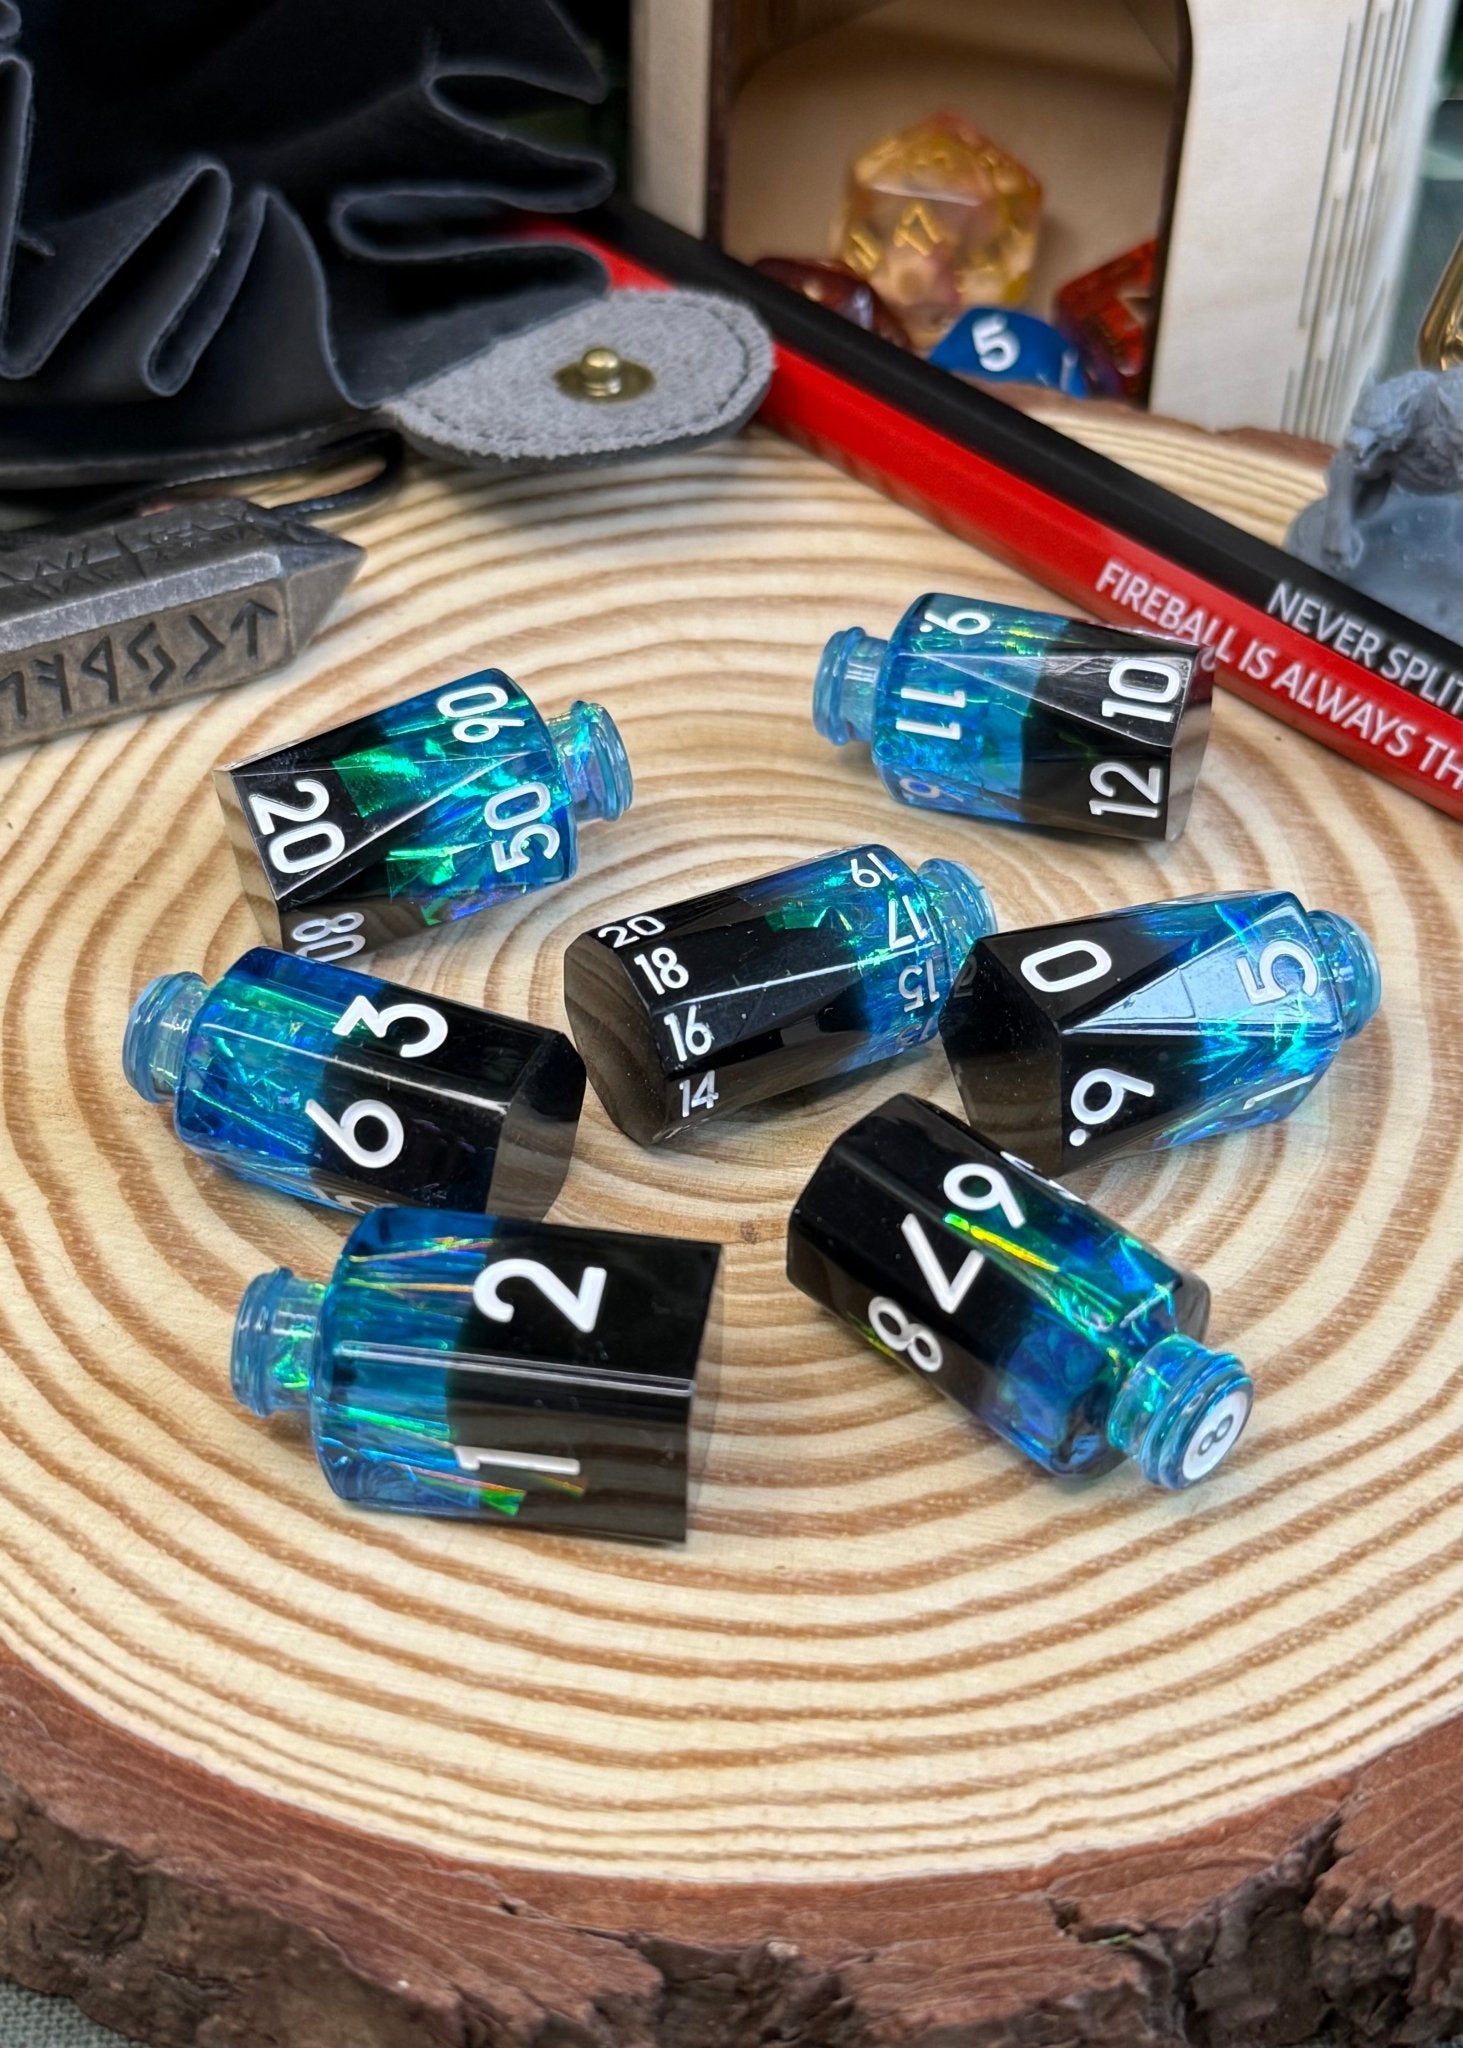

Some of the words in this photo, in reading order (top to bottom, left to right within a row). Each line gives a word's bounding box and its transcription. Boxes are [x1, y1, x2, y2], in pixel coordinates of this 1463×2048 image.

[971, 314, 1020, 373] 5
[1266, 582, 1378, 669] NEVER
[1096, 560, 1237, 663] FIREBALL
[1239, 639, 1277, 681] IS
[1271, 662, 1417, 758] ALWAYS
[895, 687, 967, 741] 11
[1101, 658, 1182, 724] 10
[1088, 760, 1163, 820] 12
[248, 778, 346, 875] 20
[483, 781, 561, 874] 50
[597, 914, 667, 950] 20
[887, 894, 930, 951] 17
[633, 946, 691, 996] 18
[1020, 939, 1113, 994] 0
[1236, 938, 1320, 1008] 5
[331, 994, 450, 1060] 3
[663, 1004, 716, 1063] 16
[679, 1070, 720, 1119] 14
[900, 1213, 986, 1315] 7
[472, 1257, 608, 1334] 2
[867, 1295, 944, 1373] 8
[454, 1445, 582, 1476] 1
[1197, 1414, 1236, 1457] 8
